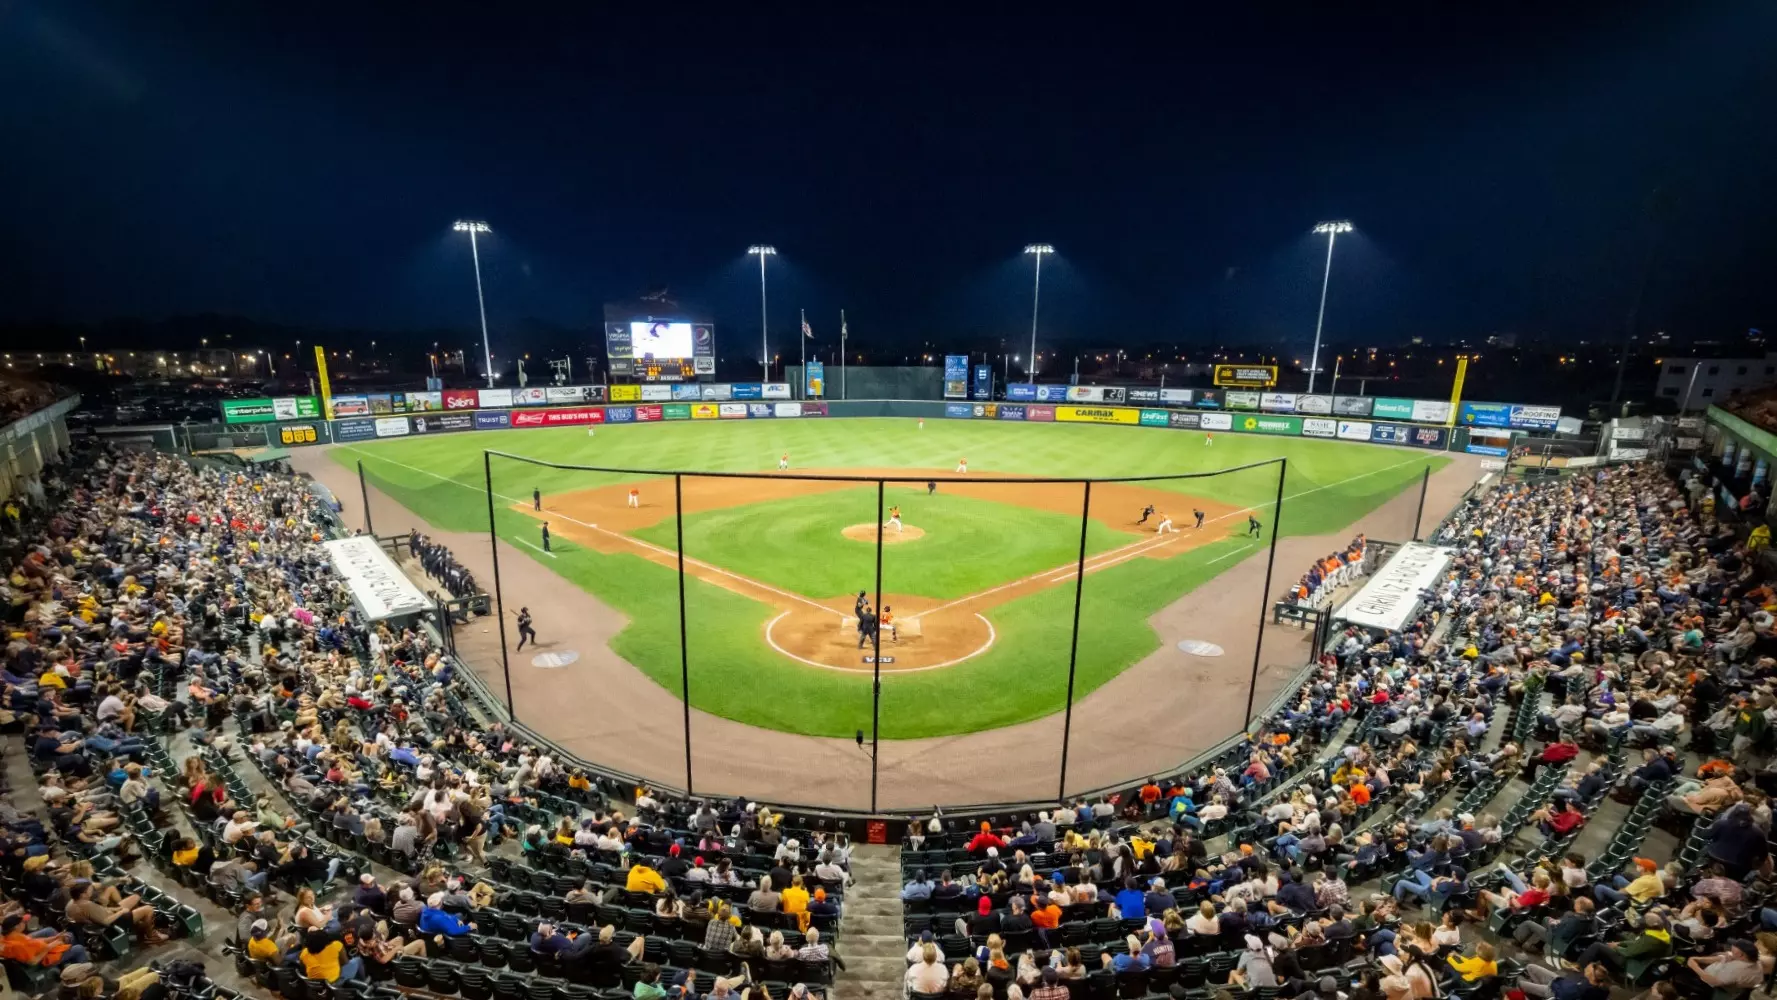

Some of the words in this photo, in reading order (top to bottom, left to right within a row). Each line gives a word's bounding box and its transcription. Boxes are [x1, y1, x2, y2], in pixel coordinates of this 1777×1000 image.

[446, 396, 475, 409] Sabra
[229, 406, 273, 416] enterprise
[1524, 411, 1558, 419] ROOFING
